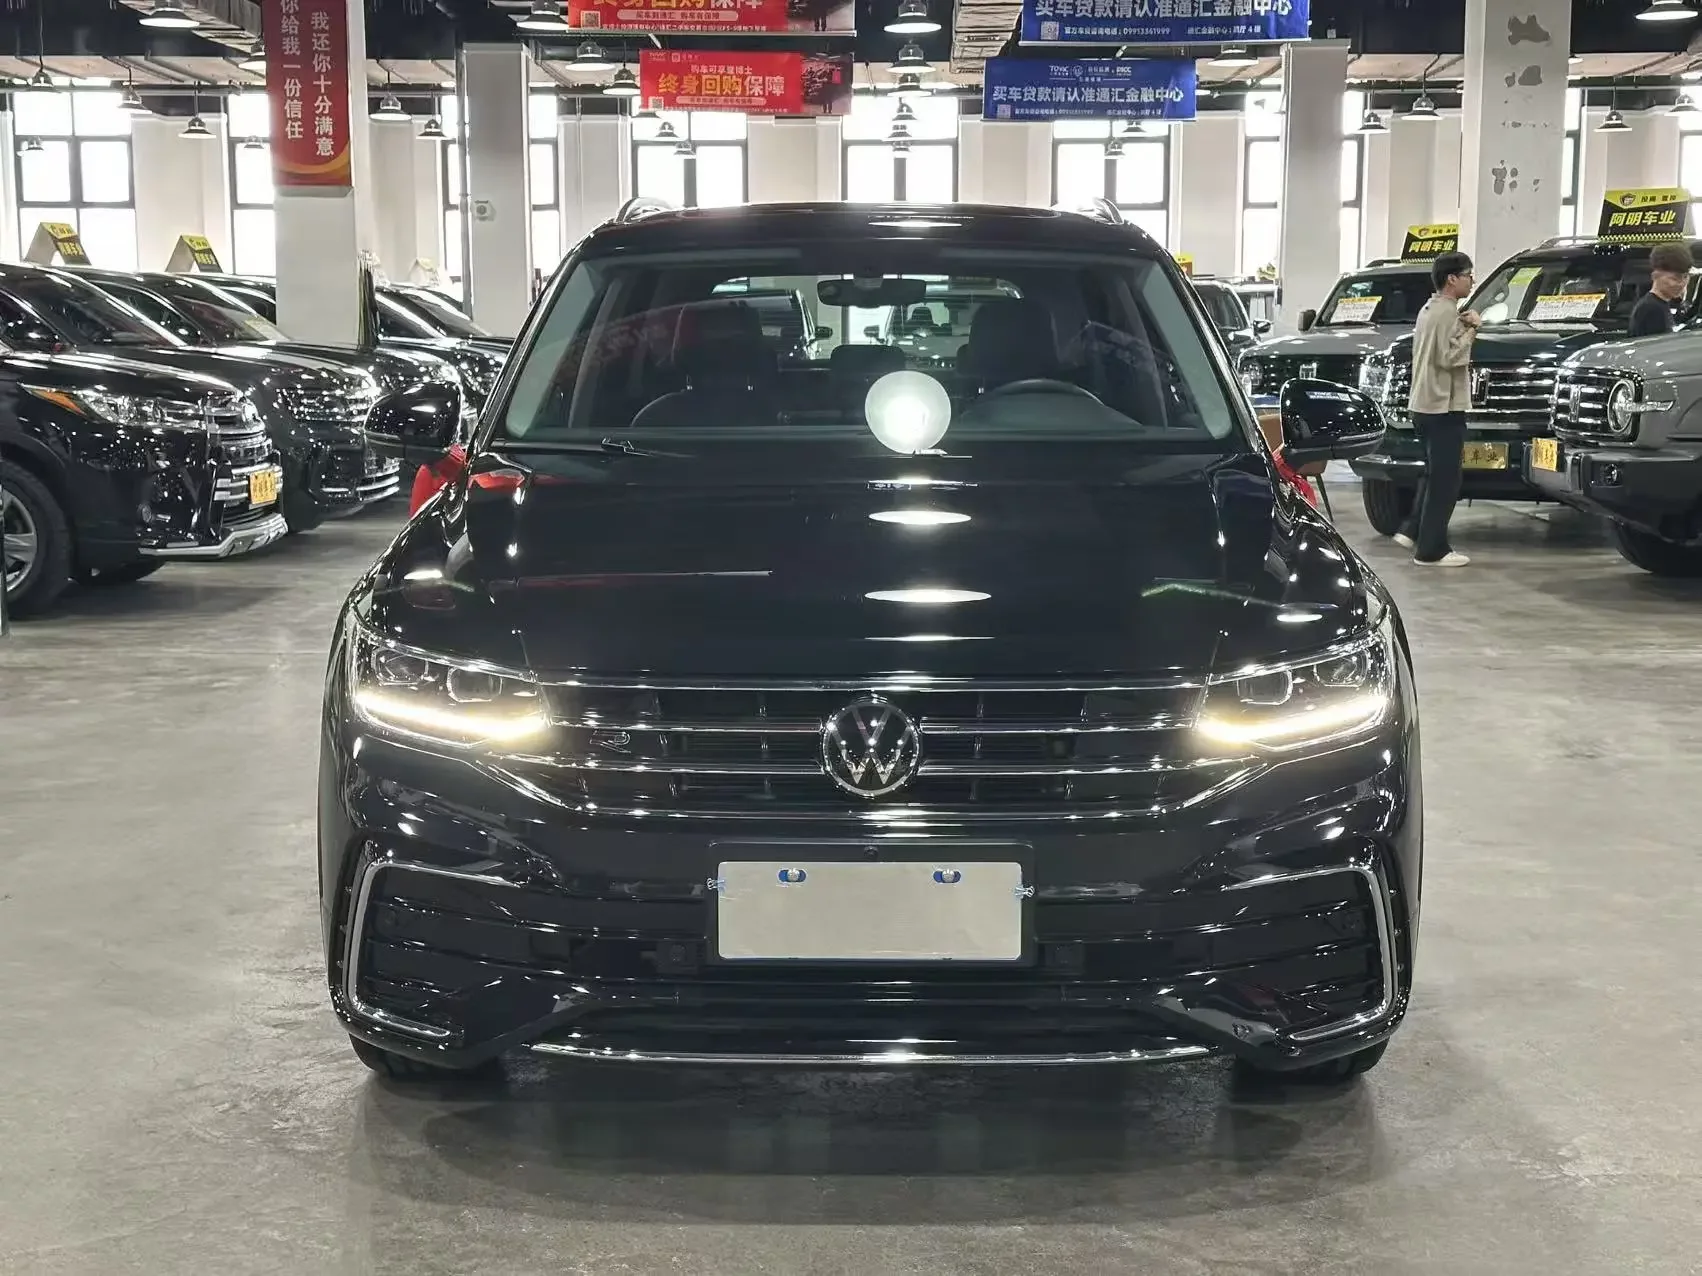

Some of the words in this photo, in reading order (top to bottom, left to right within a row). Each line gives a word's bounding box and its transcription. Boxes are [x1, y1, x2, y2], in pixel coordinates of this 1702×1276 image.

[280, 0, 304, 139] 你给我一份信任
[311, 11, 335, 156] 我还你十分满意
[658, 73, 785, 97] 终身回购保障
[992, 85, 1184, 103] 买车贷款请认准通汇金融中心
[1609, 210, 1676, 227] 阿明车业
[1408, 240, 1455, 253] 阿明车业
